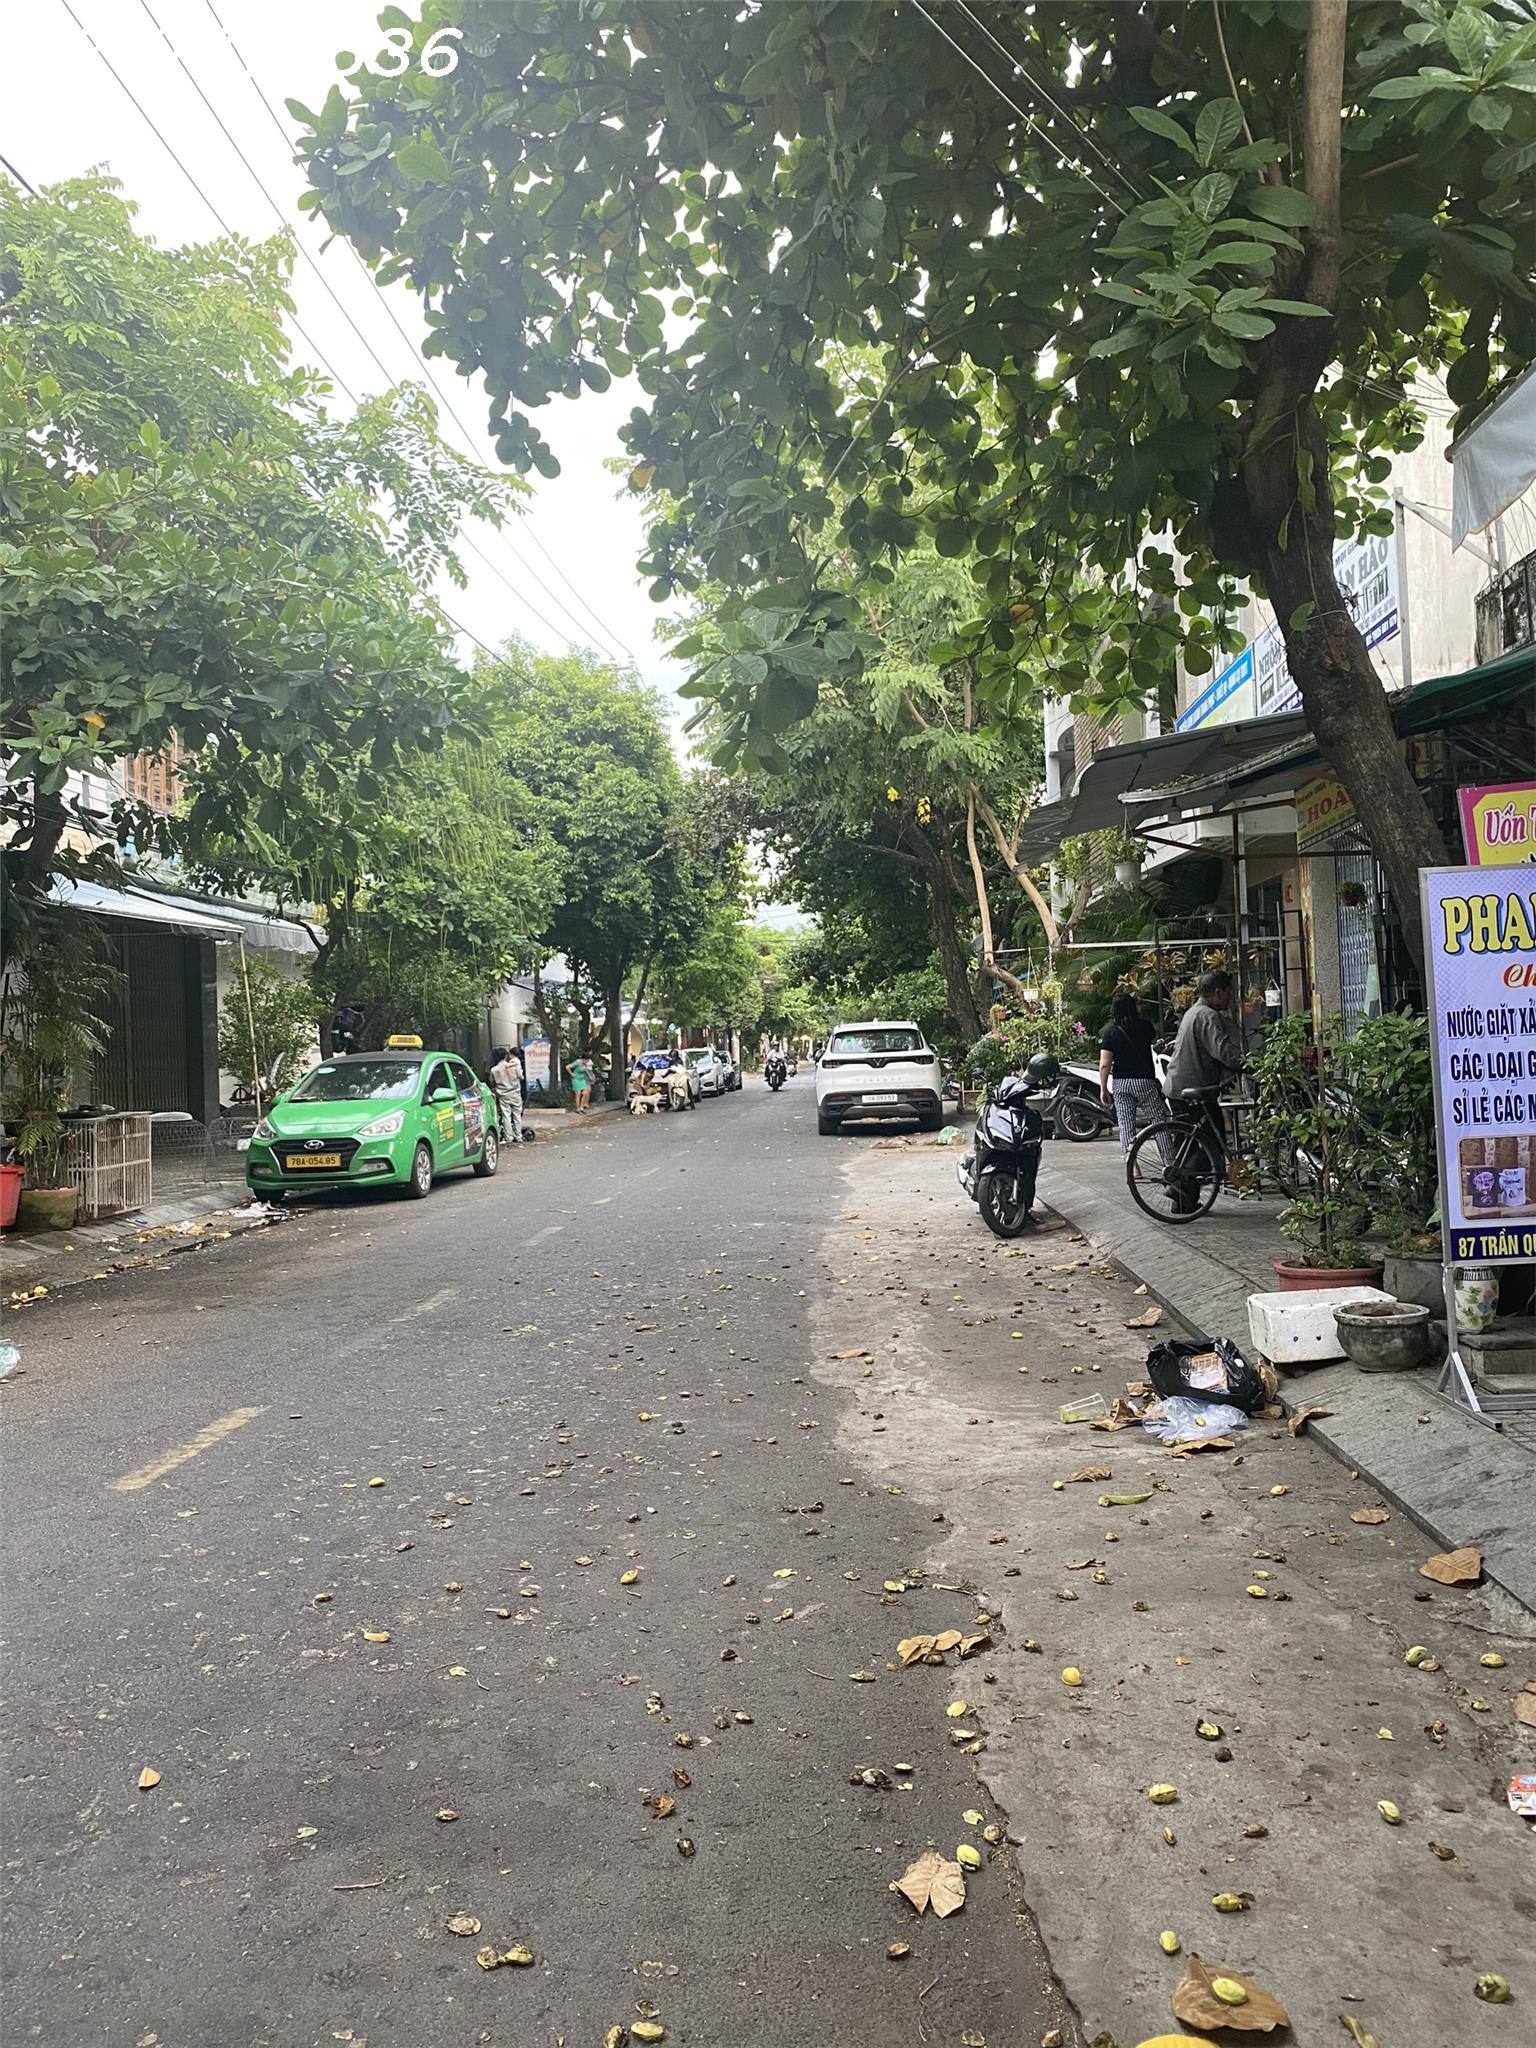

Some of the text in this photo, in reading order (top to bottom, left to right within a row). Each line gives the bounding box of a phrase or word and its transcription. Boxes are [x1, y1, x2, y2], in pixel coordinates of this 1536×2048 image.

[1484, 802, 1528, 846] Uốn
[1440, 892, 1536, 954] PHA
[1446, 997, 1536, 1041] NƯỚC GIẶT XẢ
[1450, 1047, 1483, 1081] CÁC
[1487, 1051, 1523, 1084] LOẠI
[1453, 1088, 1468, 1124] SỈ
[1472, 1087, 1490, 1123] LẺ
[1493, 1089, 1524, 1122] CÁC
[1458, 1237, 1475, 1257] 87
[1480, 1228, 1519, 1256] TRẦN
